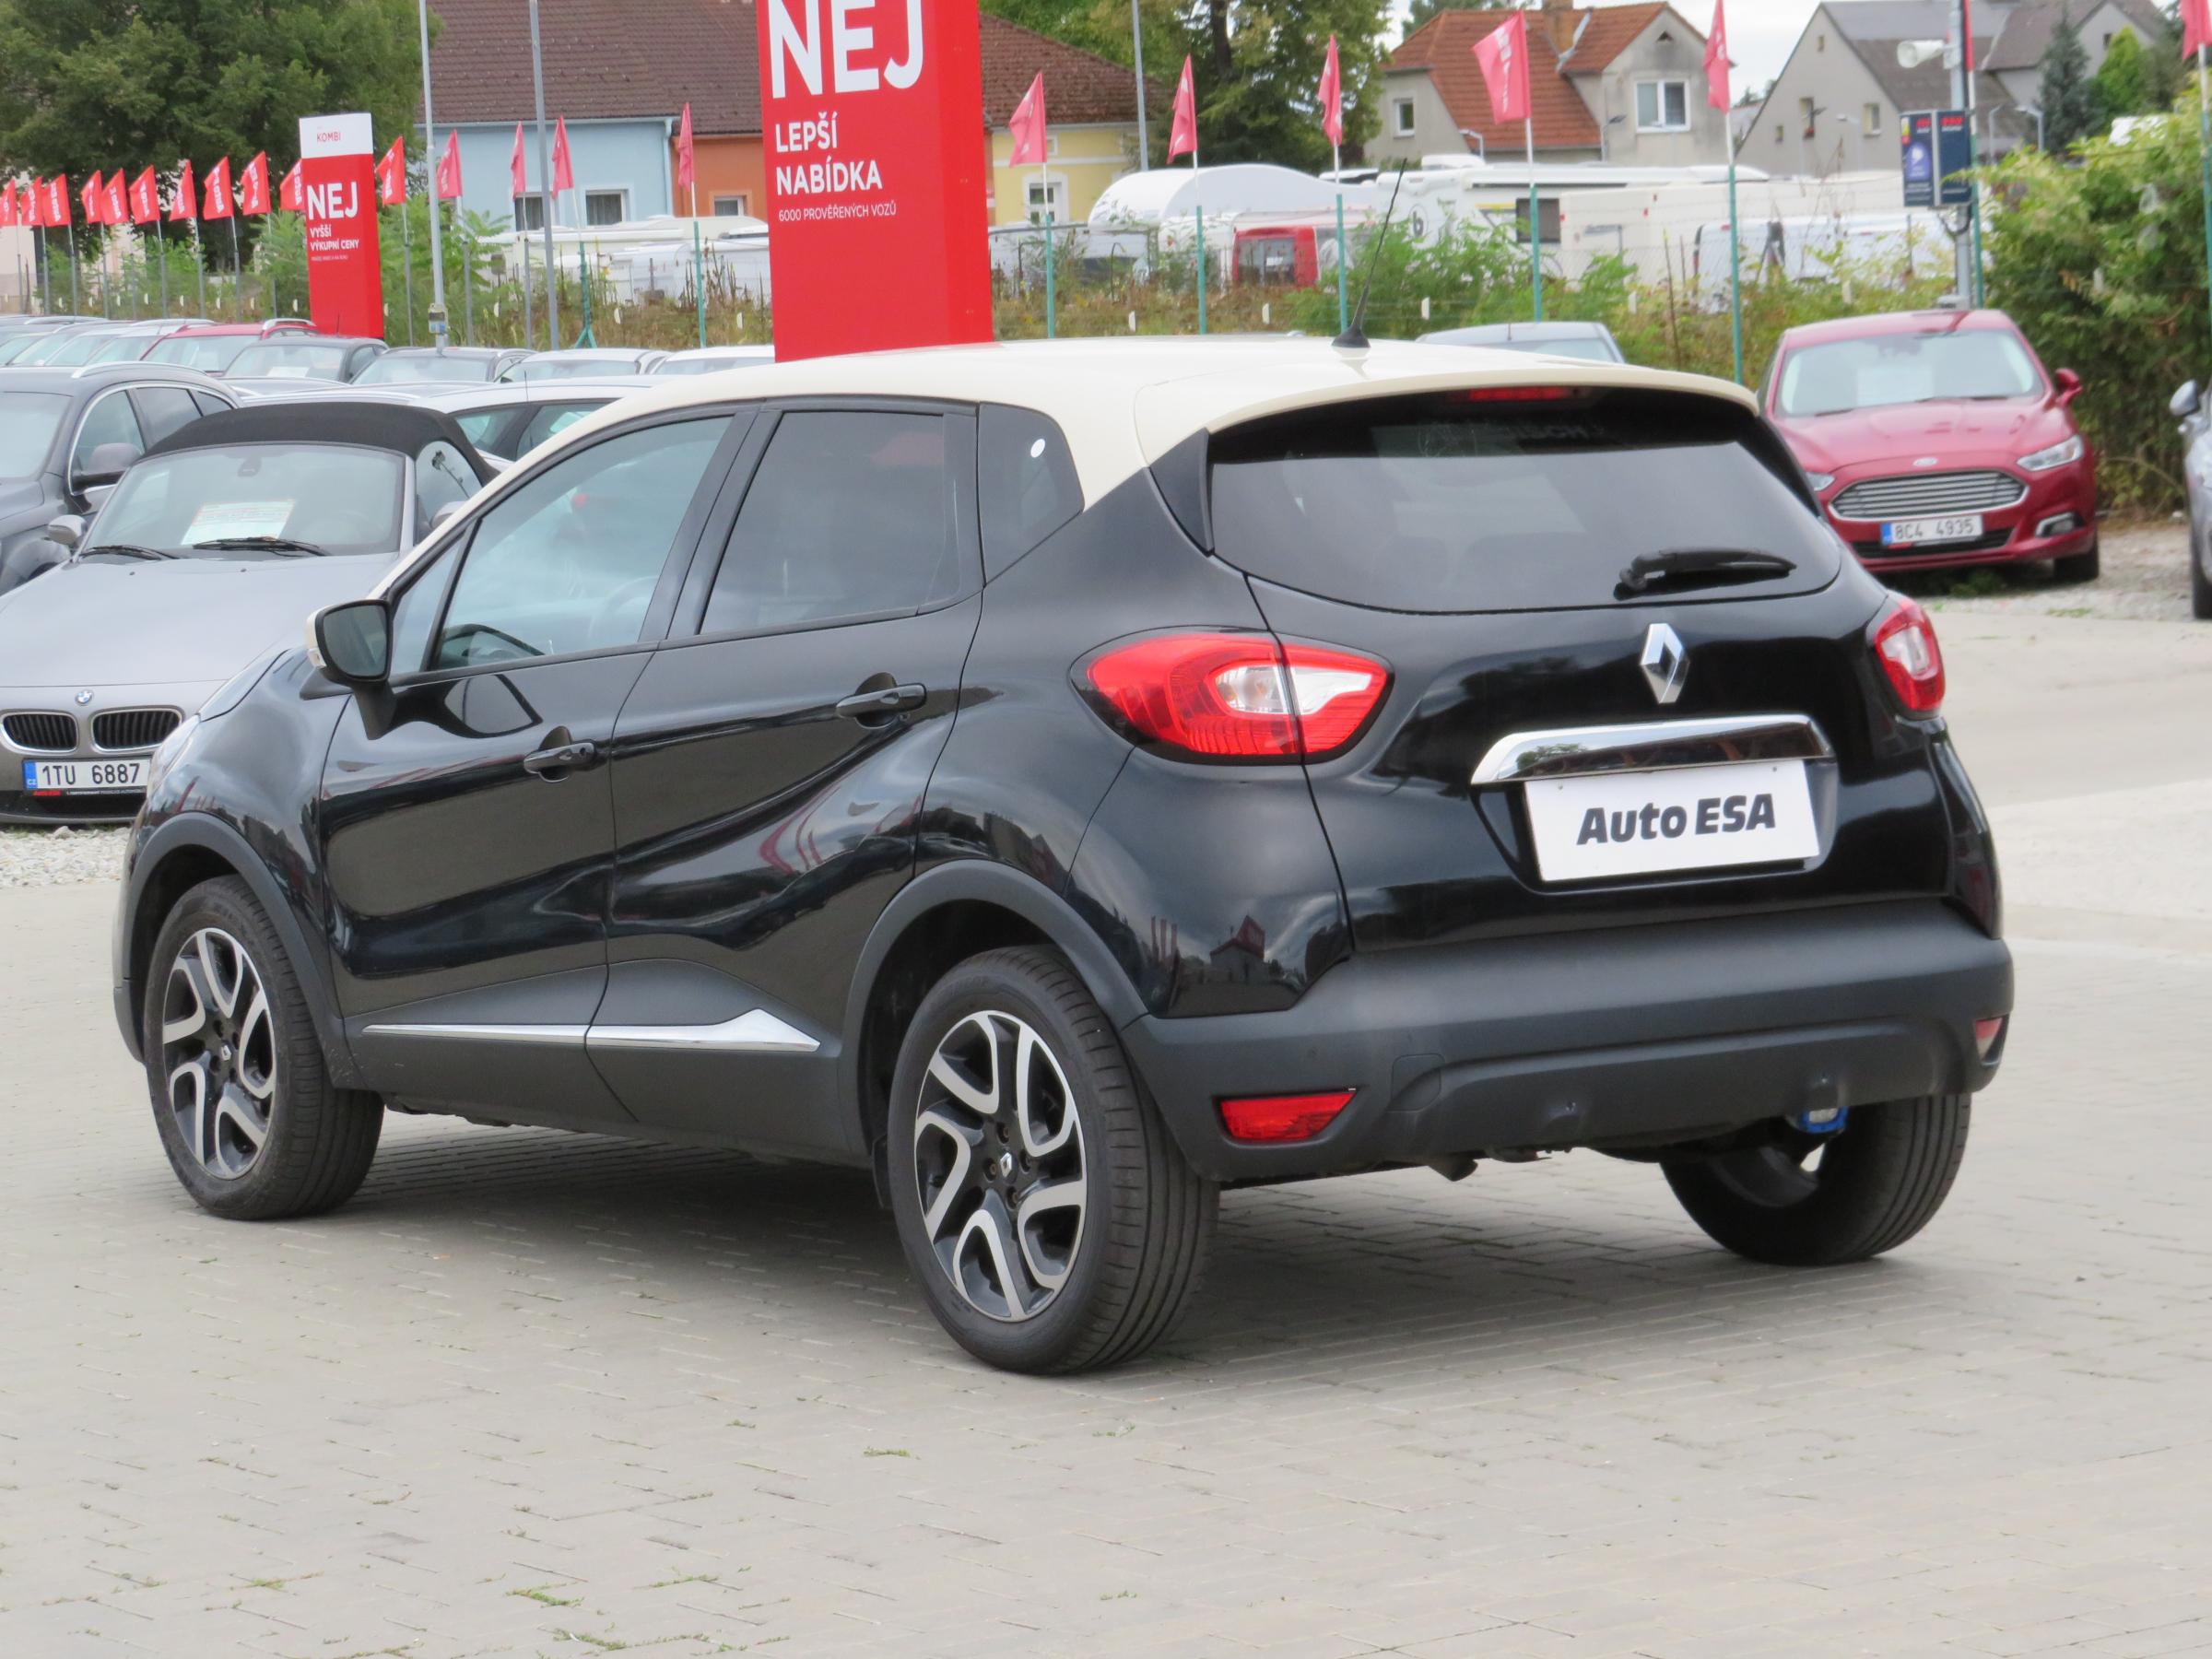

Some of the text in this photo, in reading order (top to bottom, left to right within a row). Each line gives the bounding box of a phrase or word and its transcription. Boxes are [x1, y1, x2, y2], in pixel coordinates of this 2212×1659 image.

[768, 0, 924, 100] NEJ
[316, 131, 341, 144] KOMBI
[775, 111, 838, 153] LEPŠÍ
[776, 155, 884, 196] NABÍDKA
[306, 182, 359, 220] NEJ
[779, 198, 897, 222] 6000 PROVĚŘENÝCH VOZŮ
[310, 224, 332, 239] VYŠŠÍ
[340, 239, 360, 251] CENY
[1895, 517, 1975, 540] 8C4 4935
[42, 762, 141, 786] 1TU 6887
[1576, 793, 1777, 846] Auto ESA
